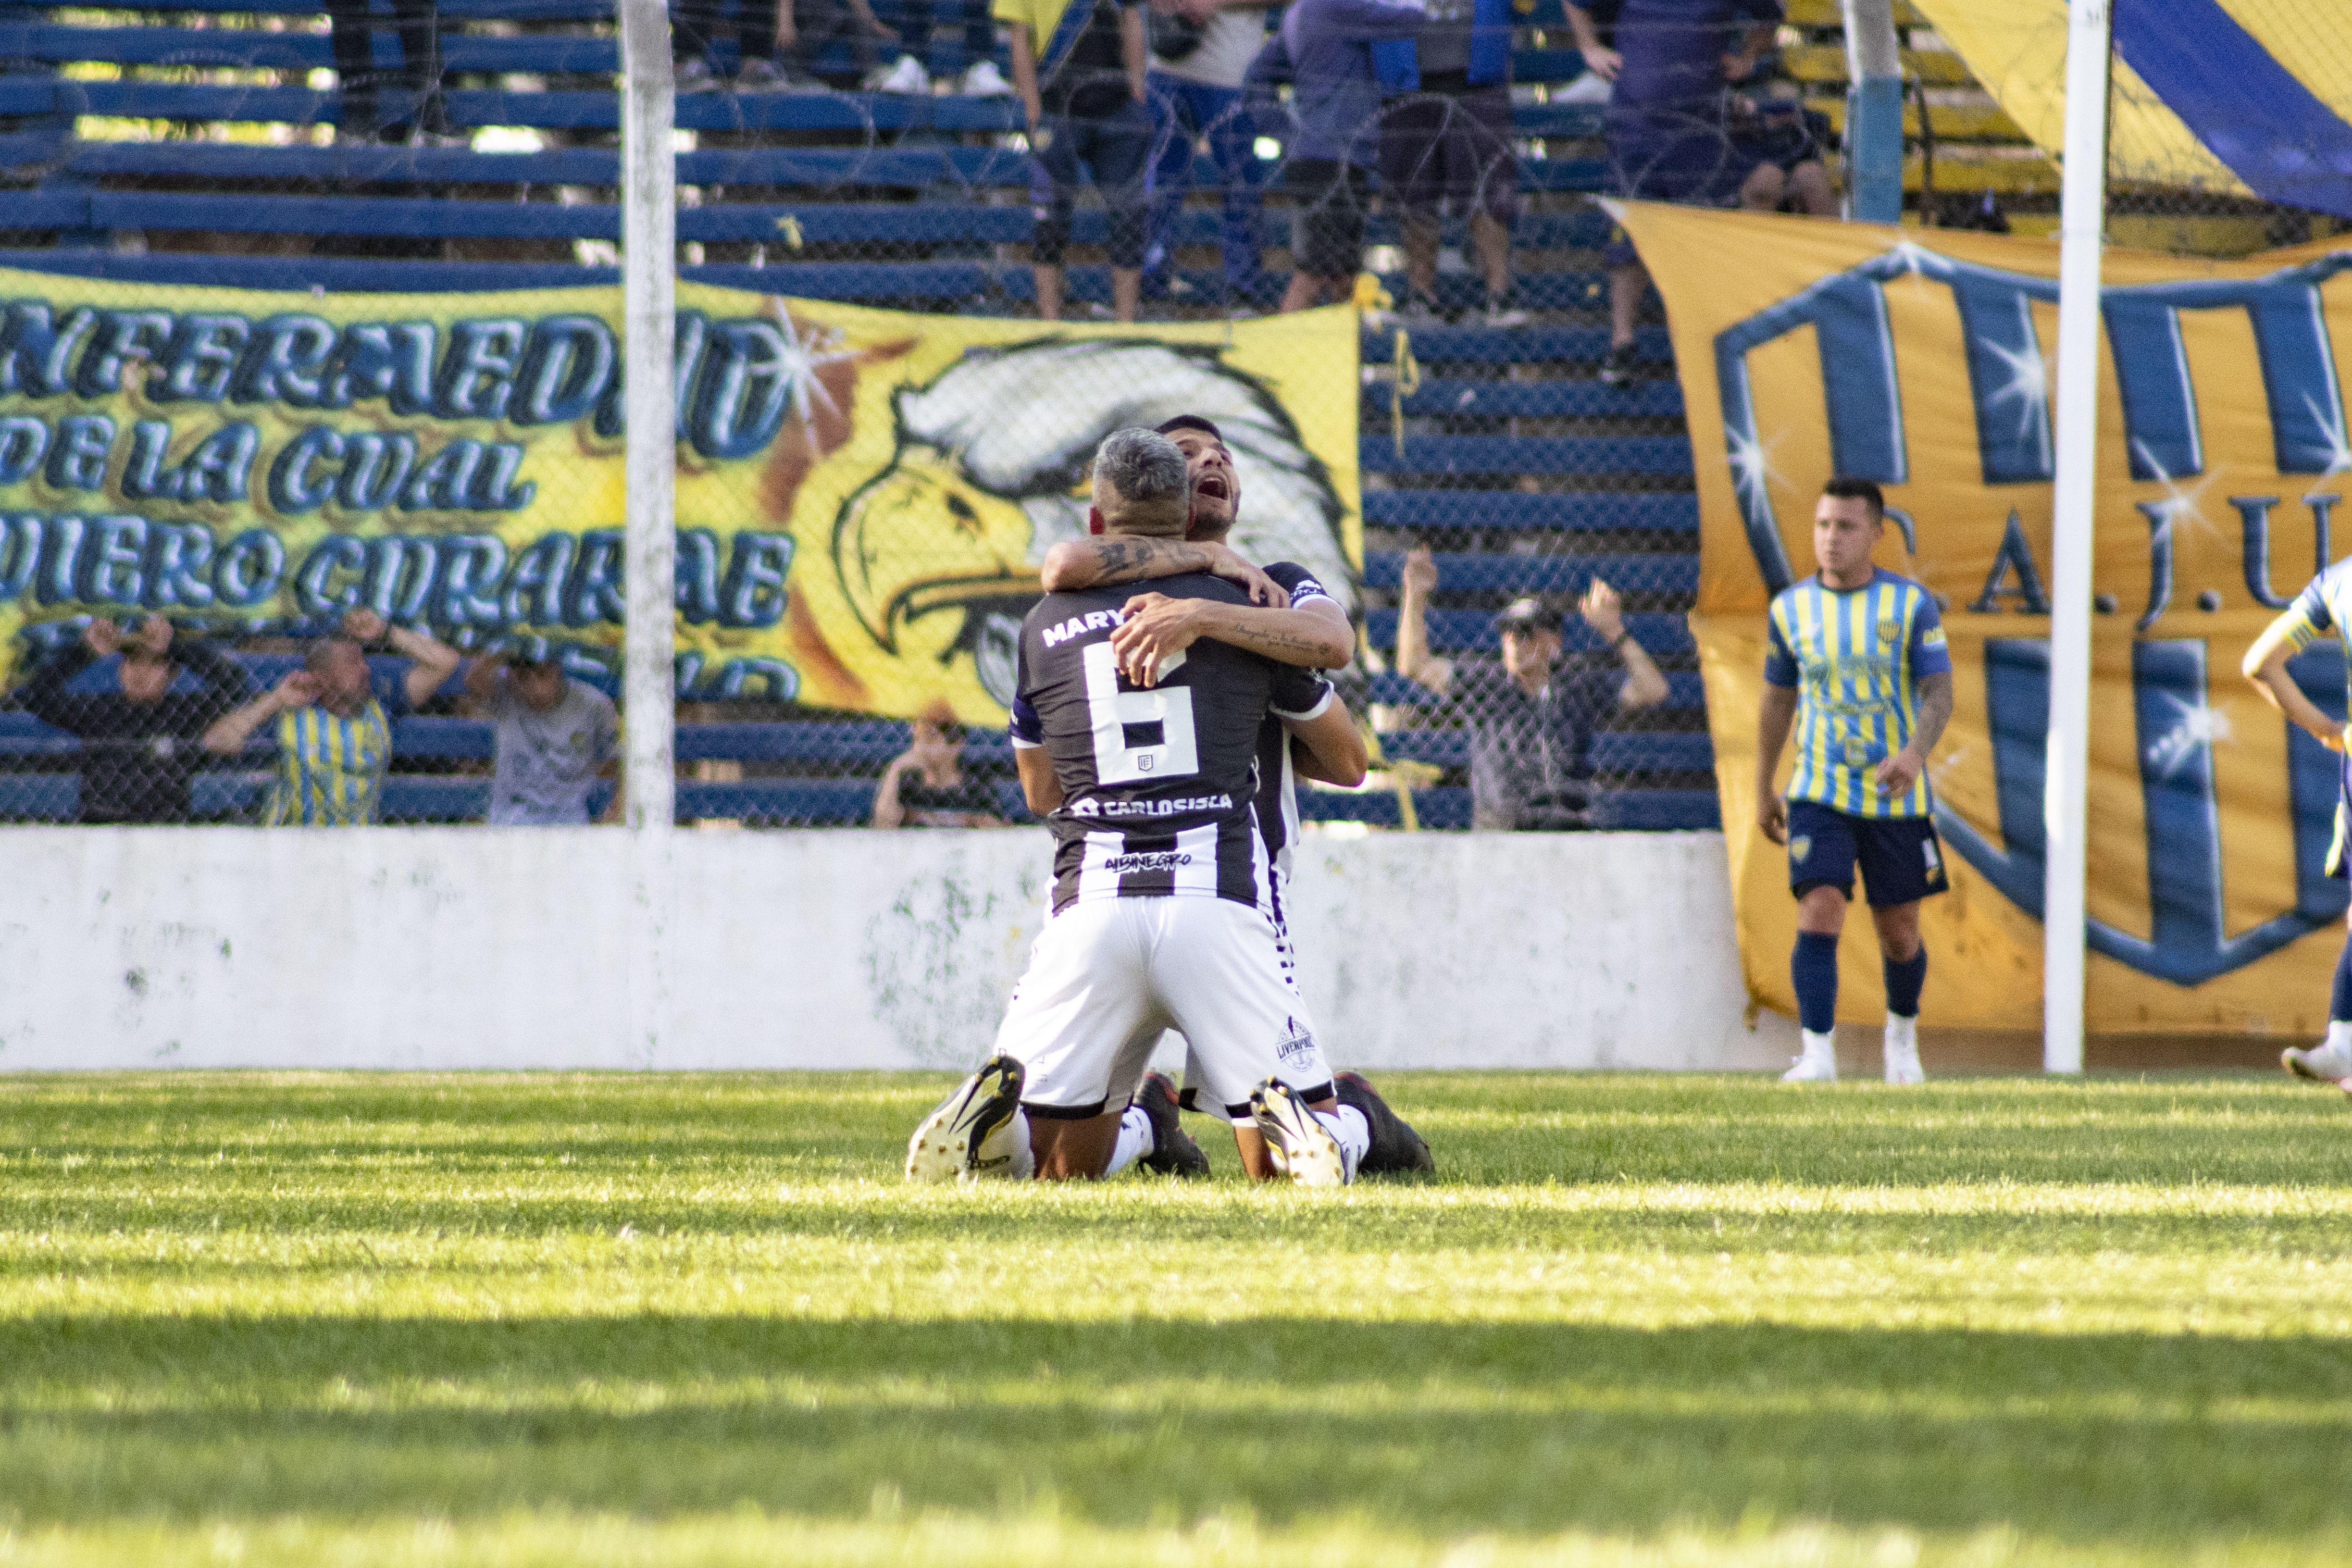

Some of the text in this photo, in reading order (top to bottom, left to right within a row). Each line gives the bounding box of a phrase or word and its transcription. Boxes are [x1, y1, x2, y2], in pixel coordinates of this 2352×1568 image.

[121, 421, 259, 503] LA
[268, 425, 537, 514] CUAL
[1042, 609, 1141, 648] MARY
[1083, 640, 1199, 785] 6
[1104, 852, 1192, 873] ALBINEGRO
